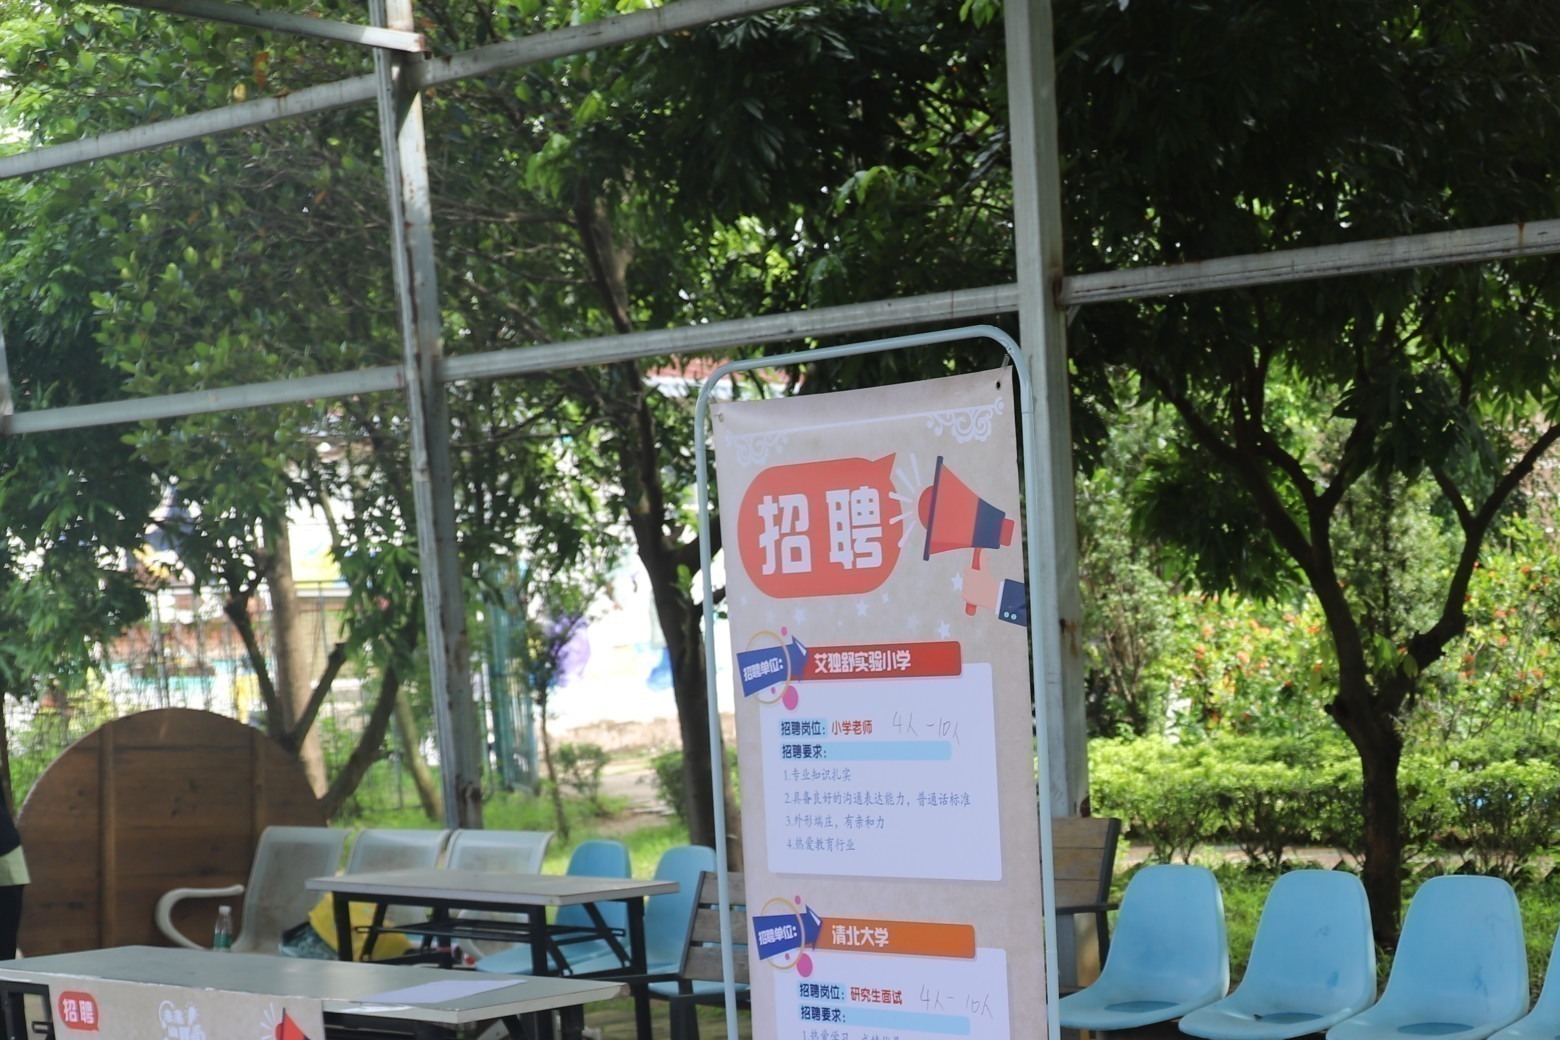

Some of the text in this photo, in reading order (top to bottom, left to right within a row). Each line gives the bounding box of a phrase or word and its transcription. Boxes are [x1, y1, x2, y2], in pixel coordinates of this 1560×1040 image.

[758, 486, 883, 575] 招聘
[814, 650, 911, 673] 艾独舒实验小学
[831, 925, 889, 947] 清北大学
[61, 998, 95, 1025] 招聘
